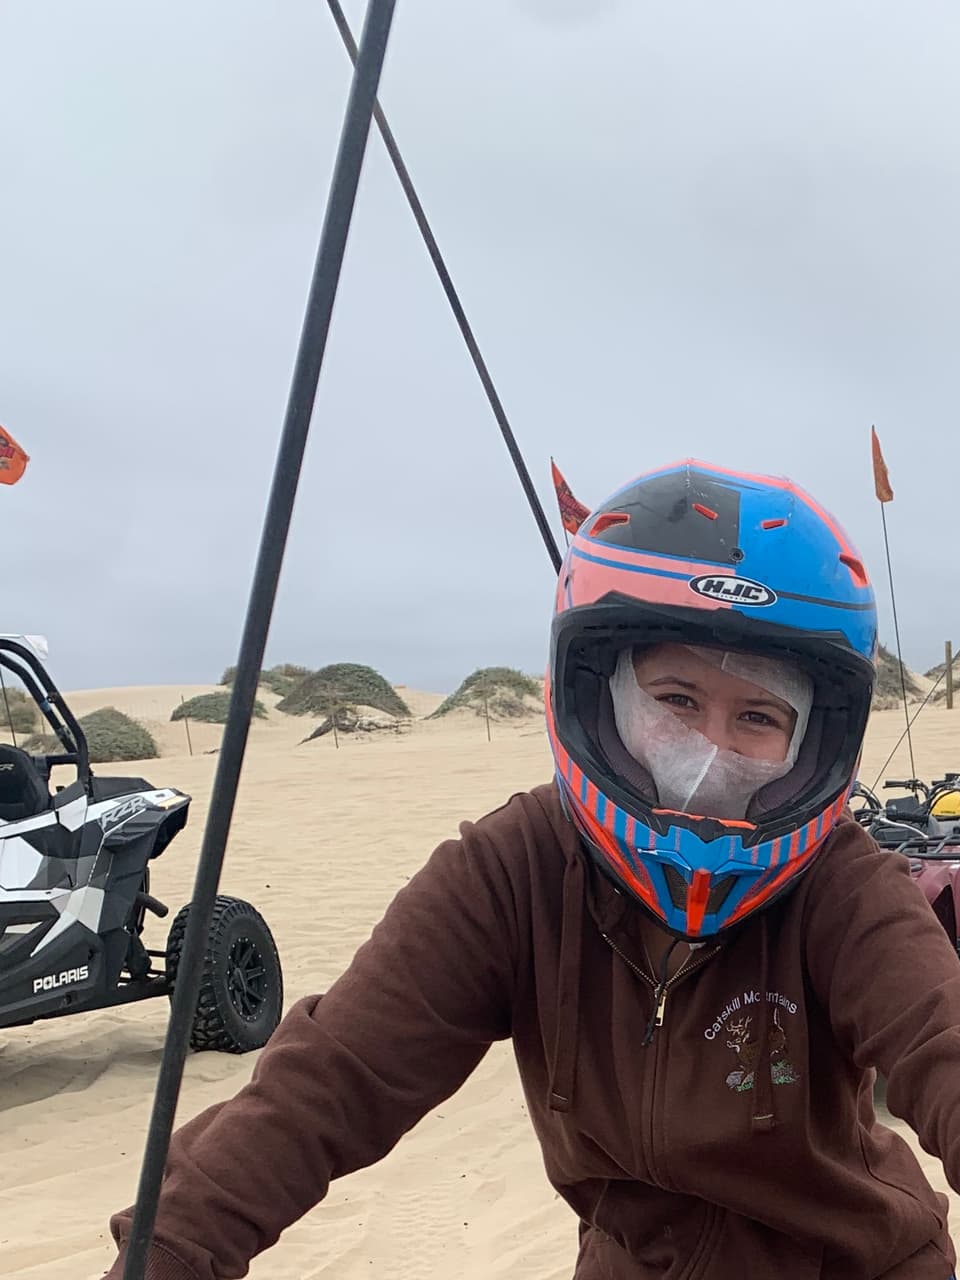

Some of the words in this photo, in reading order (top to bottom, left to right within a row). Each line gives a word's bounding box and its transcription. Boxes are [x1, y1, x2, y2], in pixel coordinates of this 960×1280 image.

[702, 579, 764, 601] HJC
[101, 797, 147, 831] RZR
[32, 965, 89, 994] POLARIS
[704, 996, 742, 1040] Catskill
